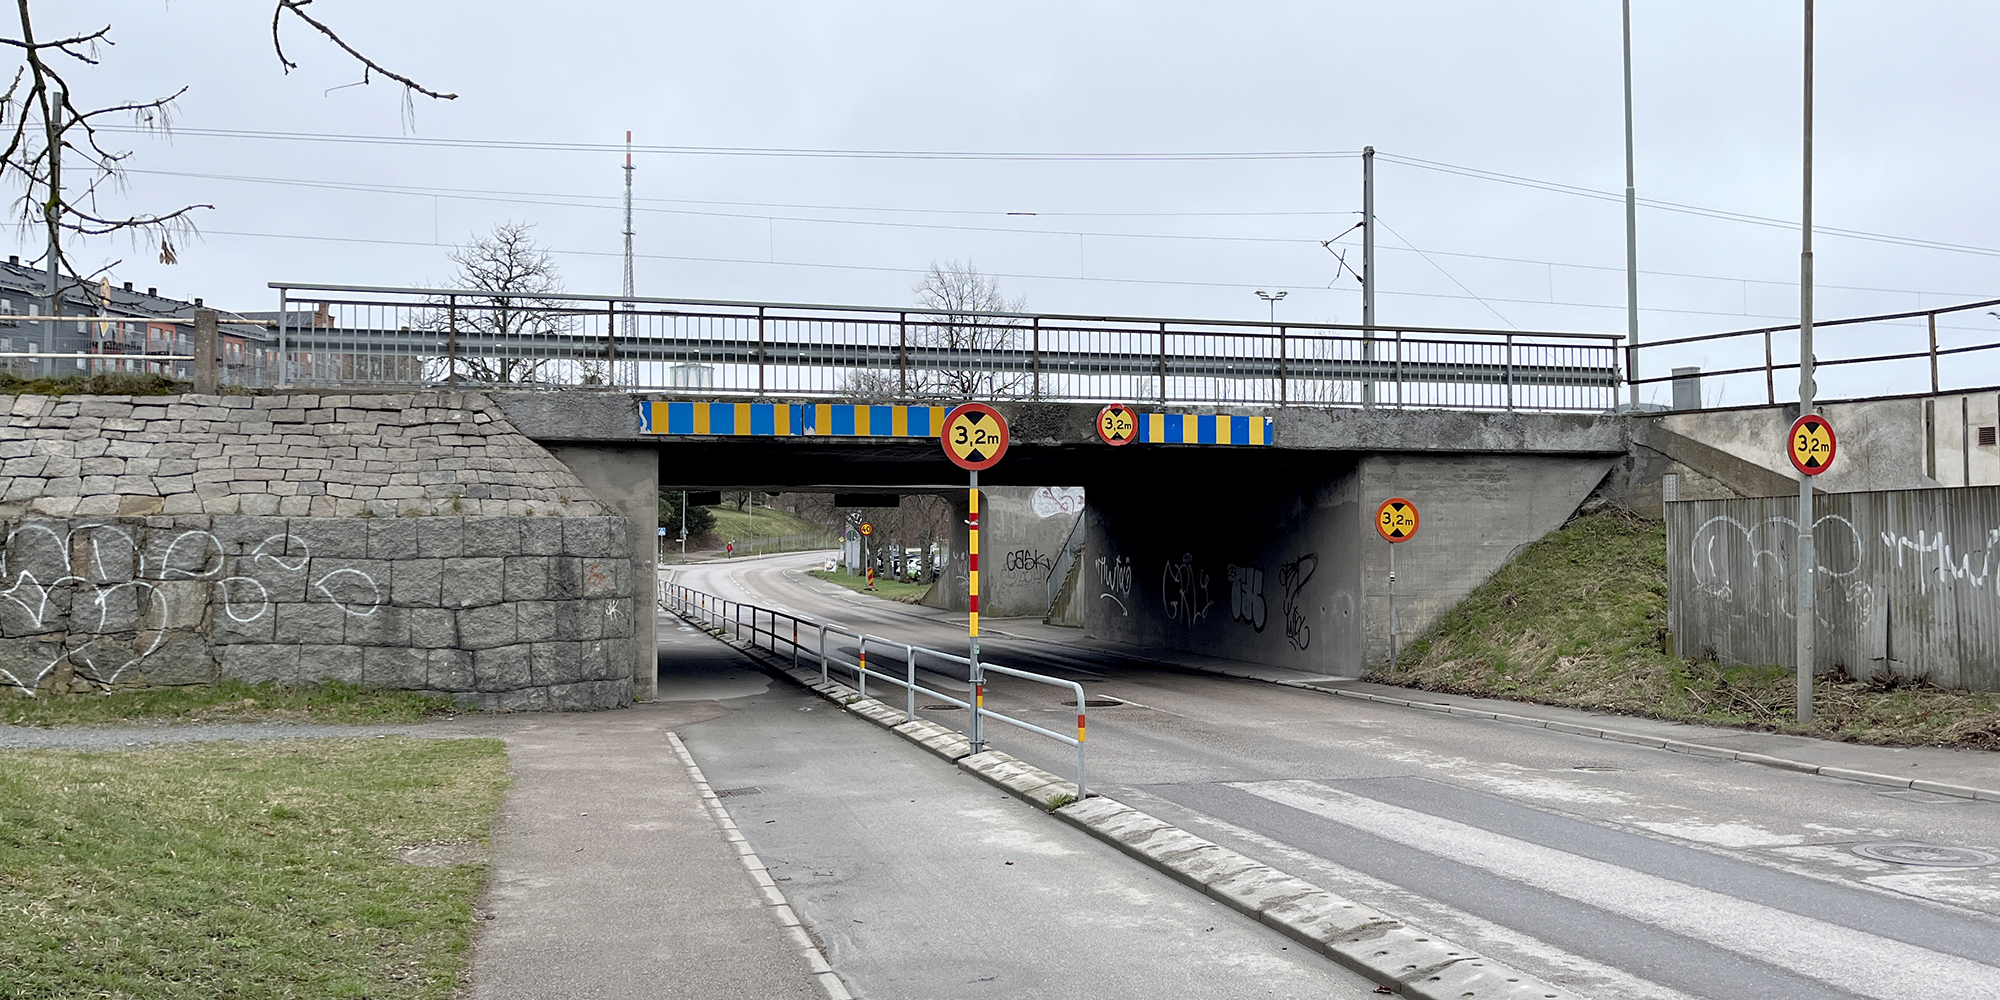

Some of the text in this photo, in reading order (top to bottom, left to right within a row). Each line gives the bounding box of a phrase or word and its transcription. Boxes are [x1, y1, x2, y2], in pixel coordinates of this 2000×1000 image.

[1105, 417, 1132, 431] 3,2m
[955, 425, 999, 448] 3,2m
[1797, 434, 1830, 454] 3,2m
[1382, 511, 1414, 528] 3,2m
